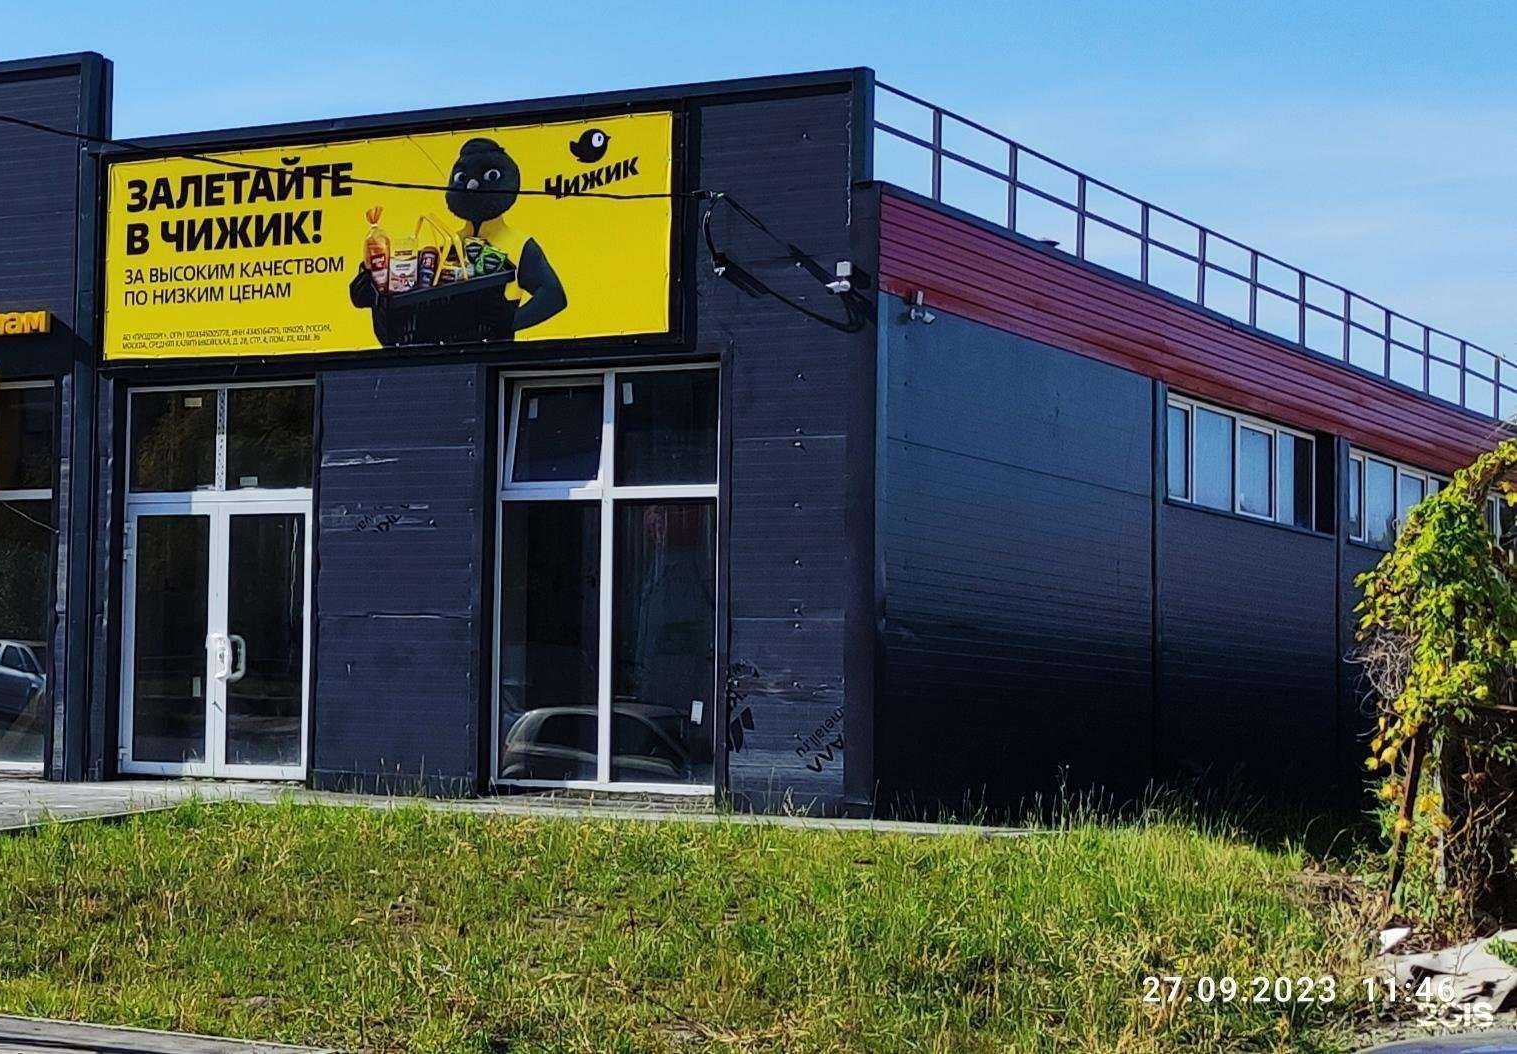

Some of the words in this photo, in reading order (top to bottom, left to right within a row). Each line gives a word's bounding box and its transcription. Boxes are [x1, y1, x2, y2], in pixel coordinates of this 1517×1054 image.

[127, 156, 353, 213] ЗАЛЕТАЙТЕ
[544, 156, 639, 200] Чижик
[126, 223, 150, 256] В
[160, 209, 323, 253] ЧИЖИК!
[125, 269, 145, 285] ЗА
[149, 263, 234, 283] ВЫСОКИМ
[240, 256, 344, 278] КАЧЕСТВОМ
[125, 290, 148, 306] ПО
[153, 286, 224, 305] НИЗКИМ
[229, 282, 291, 303] ЦЕНАМ
